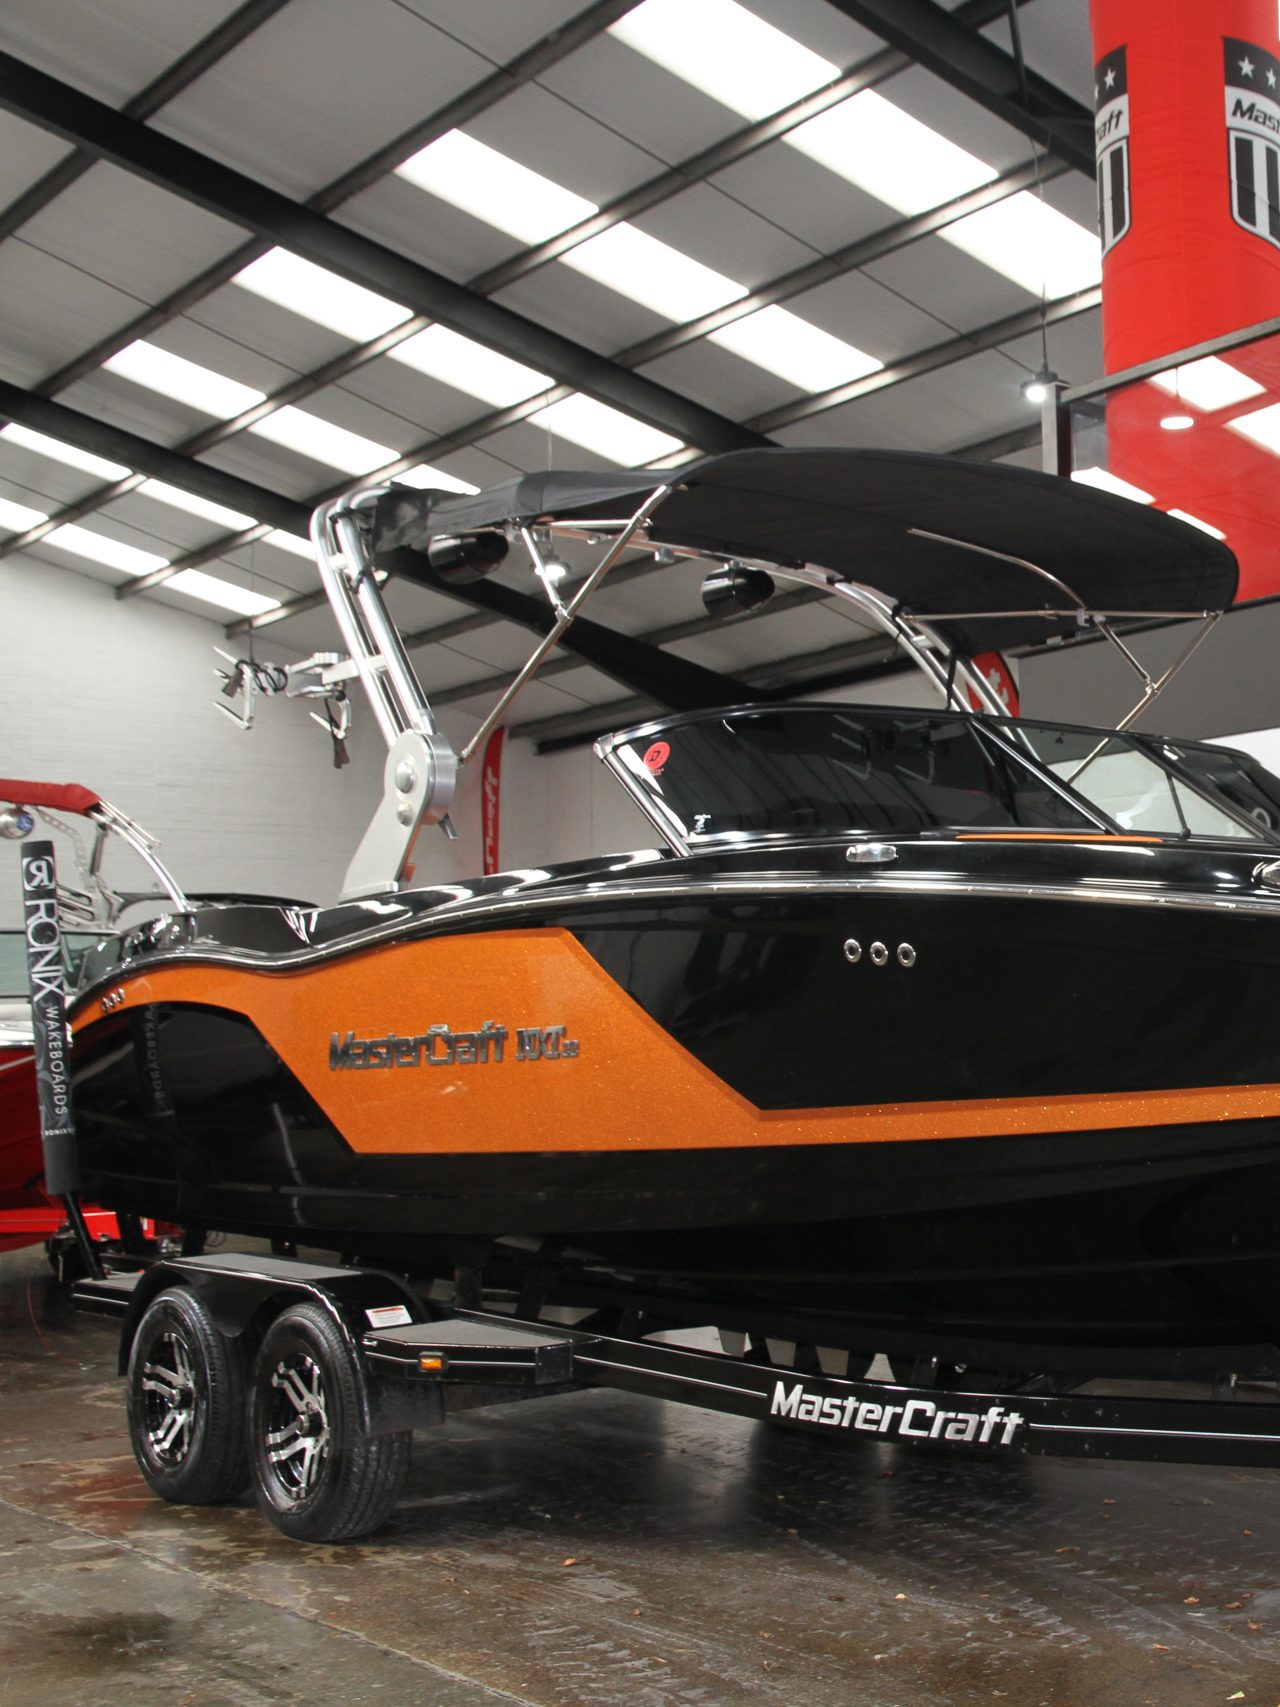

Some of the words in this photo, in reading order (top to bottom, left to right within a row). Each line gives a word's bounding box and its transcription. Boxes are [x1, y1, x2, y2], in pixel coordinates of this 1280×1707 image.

[25, 899, 66, 1002] RONIX
[45, 1005, 69, 1115] WAKEBOARDS
[329, 1020, 509, 1071] MasterCraft
[770, 1381, 1025, 1445] MasterCraft
